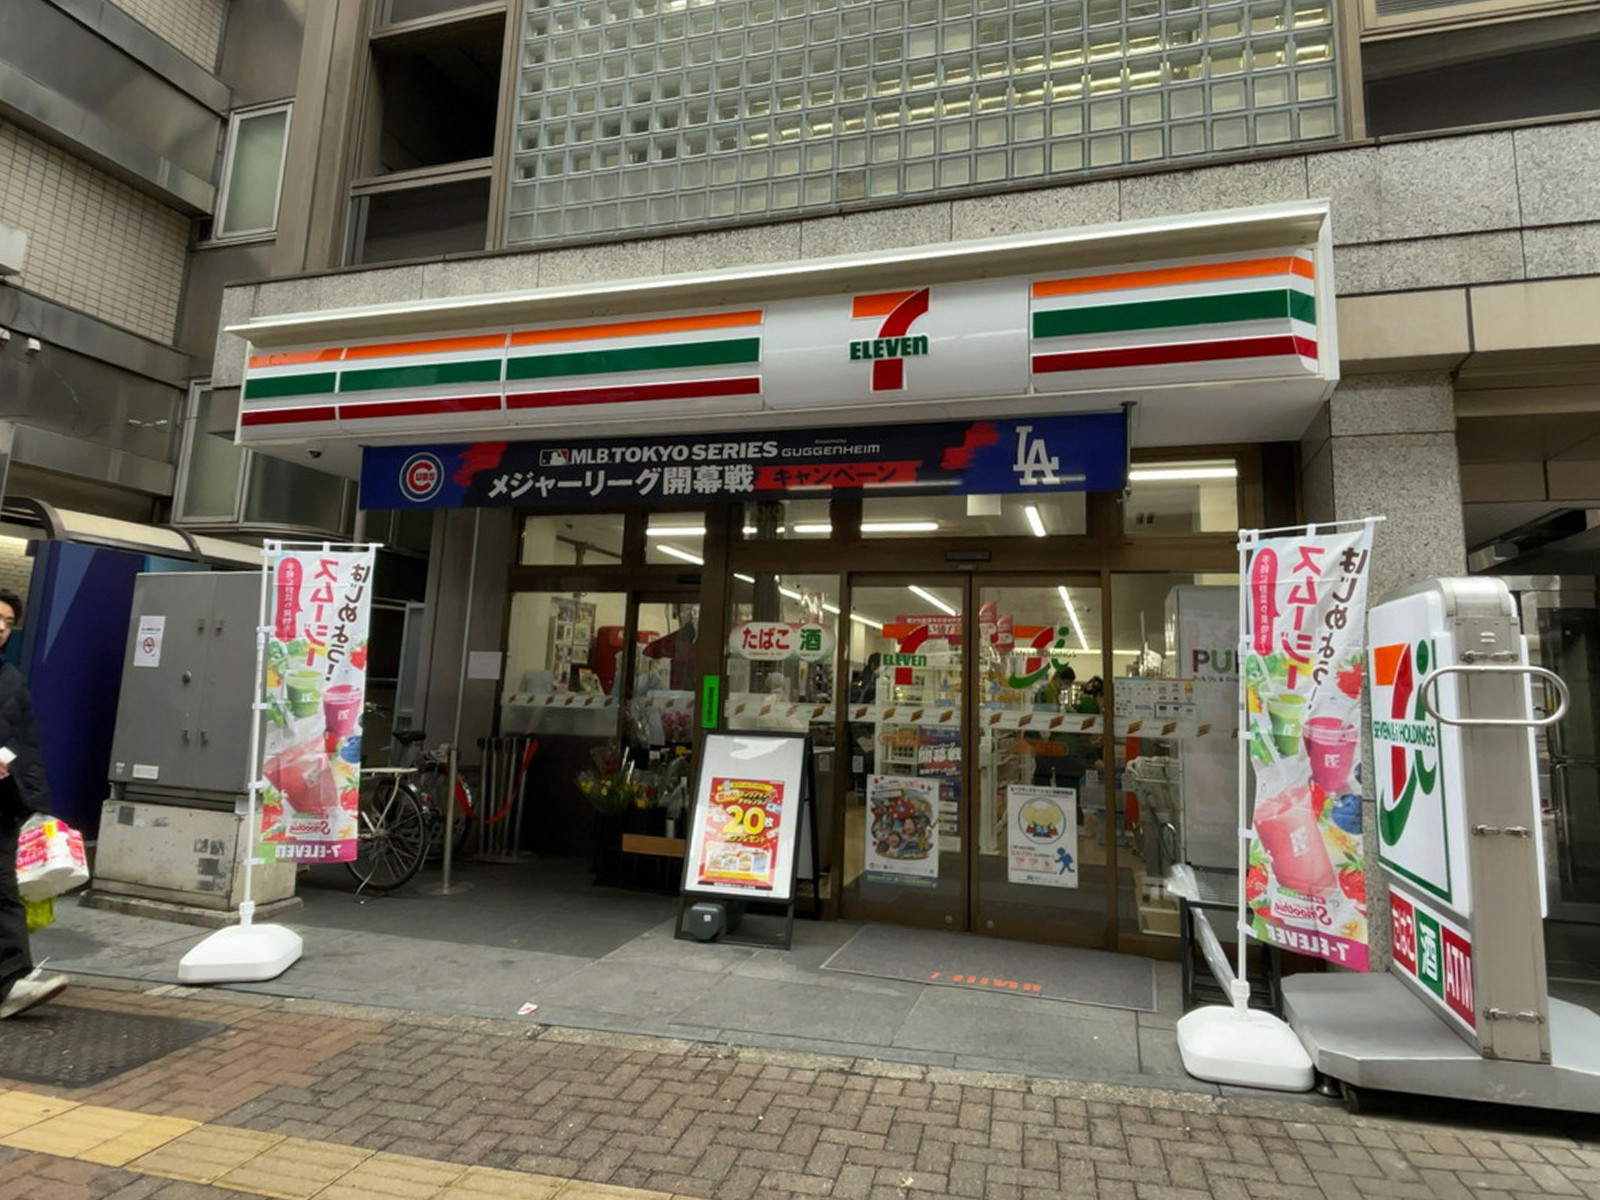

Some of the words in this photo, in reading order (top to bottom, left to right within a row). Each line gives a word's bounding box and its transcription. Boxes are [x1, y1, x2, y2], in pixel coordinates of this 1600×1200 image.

[612, 445, 693, 463] TOKYO
[692, 441, 778, 460] SERIES
[782, 444, 881, 457] GUGGENHEIM
[1013, 426, 1060, 485] LA
[488, 464, 754, 498] メジャーリーグ開幕戦
[772, 464, 899, 485] キャンペーン
[742, 628, 790, 650] たばこ
[800, 629, 821, 651] 酒
[1446, 942, 1474, 1013] ATM
